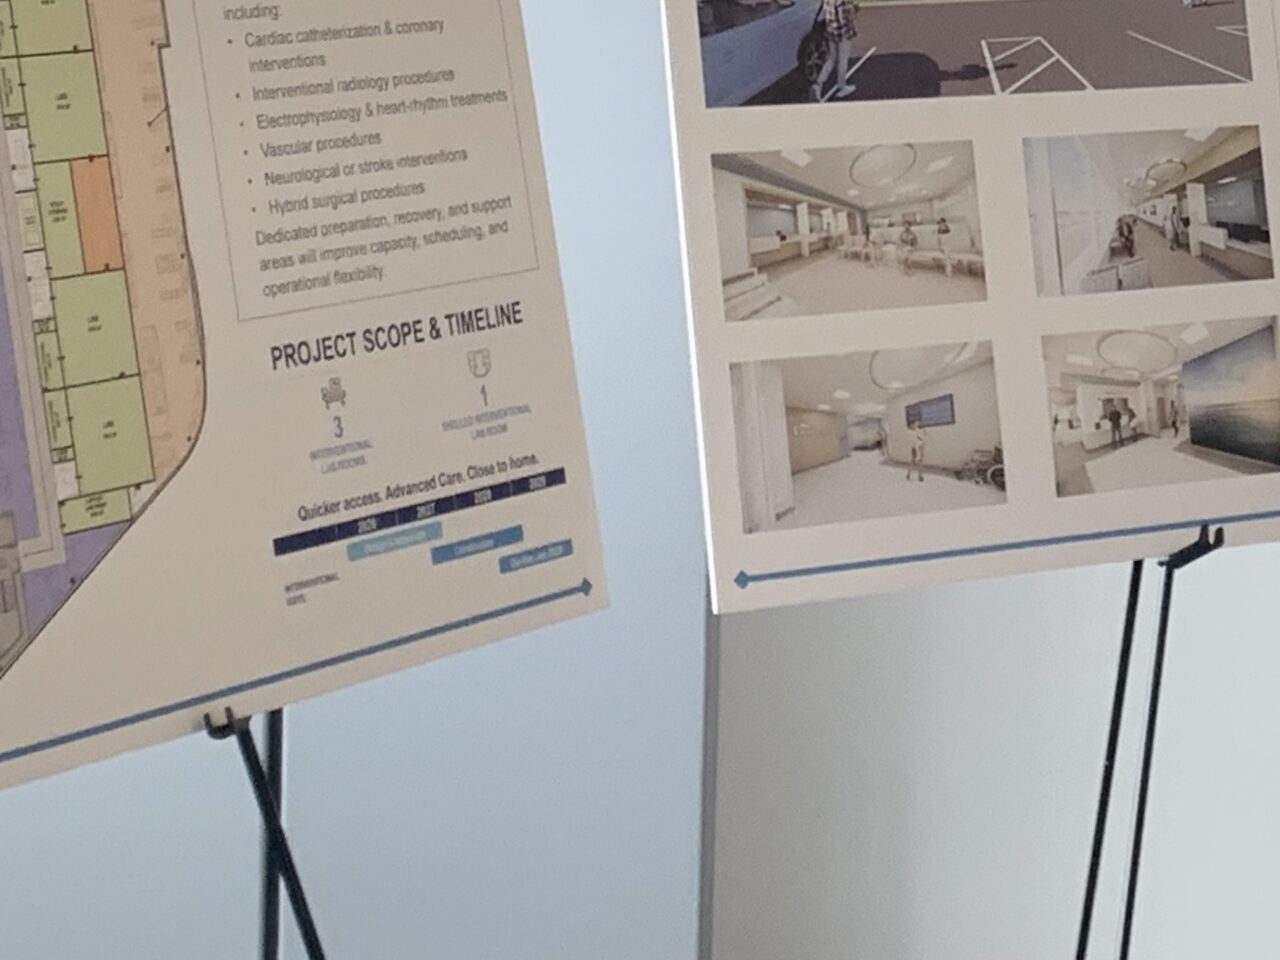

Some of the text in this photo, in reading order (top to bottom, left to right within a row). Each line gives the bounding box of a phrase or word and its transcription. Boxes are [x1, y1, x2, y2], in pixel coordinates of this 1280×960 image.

[245, 20, 444, 48] Cardiac catheterization & coronary
[250, 53, 325, 72] interventions
[253, 69, 454, 100] Interventional radiology procedures
[257, 90, 508, 130] Electrophysiology & heart-rhythm treatments
[260, 132, 381, 157] Vascular procedures
[265, 148, 467, 186] Neurological or stroke interventions
[269, 182, 425, 216] Hybrid surgical procedures
[256, 228, 316, 246] Dedicated
[448, 202, 468, 216] and
[471, 197, 511, 215] support
[260, 256, 294, 271] areas
[298, 248, 316, 263] will
[320, 242, 367, 262] improve
[488, 221, 508, 235] and
[263, 274, 330, 297] operational
[272, 302, 523, 370] PROJECT SCOPE & TIMELINE
[481, 385, 488, 406] 1
[334, 416, 343, 438] 3
[298, 496, 341, 521] Quicker
[386, 479, 436, 501] Advanced
[467, 463, 495, 480] Close
[497, 462, 507, 473] to
